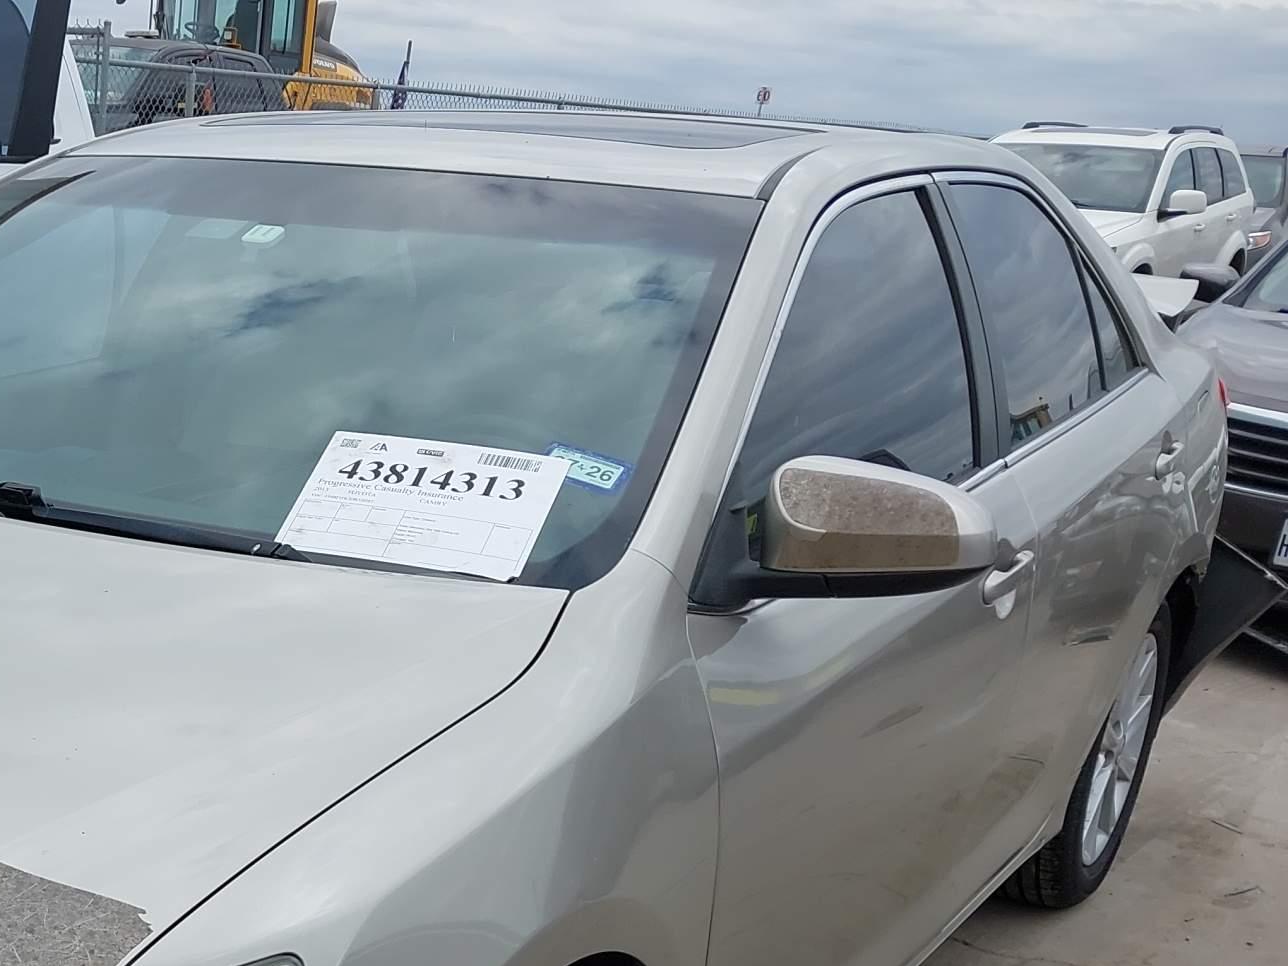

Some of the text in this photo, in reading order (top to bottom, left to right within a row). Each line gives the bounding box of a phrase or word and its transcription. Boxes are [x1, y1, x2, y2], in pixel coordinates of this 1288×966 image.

[338, 458, 526, 501] 43814313
[584, 465, 616, 482] 26
[318, 478, 465, 503] Progressive Casualty Insurance
